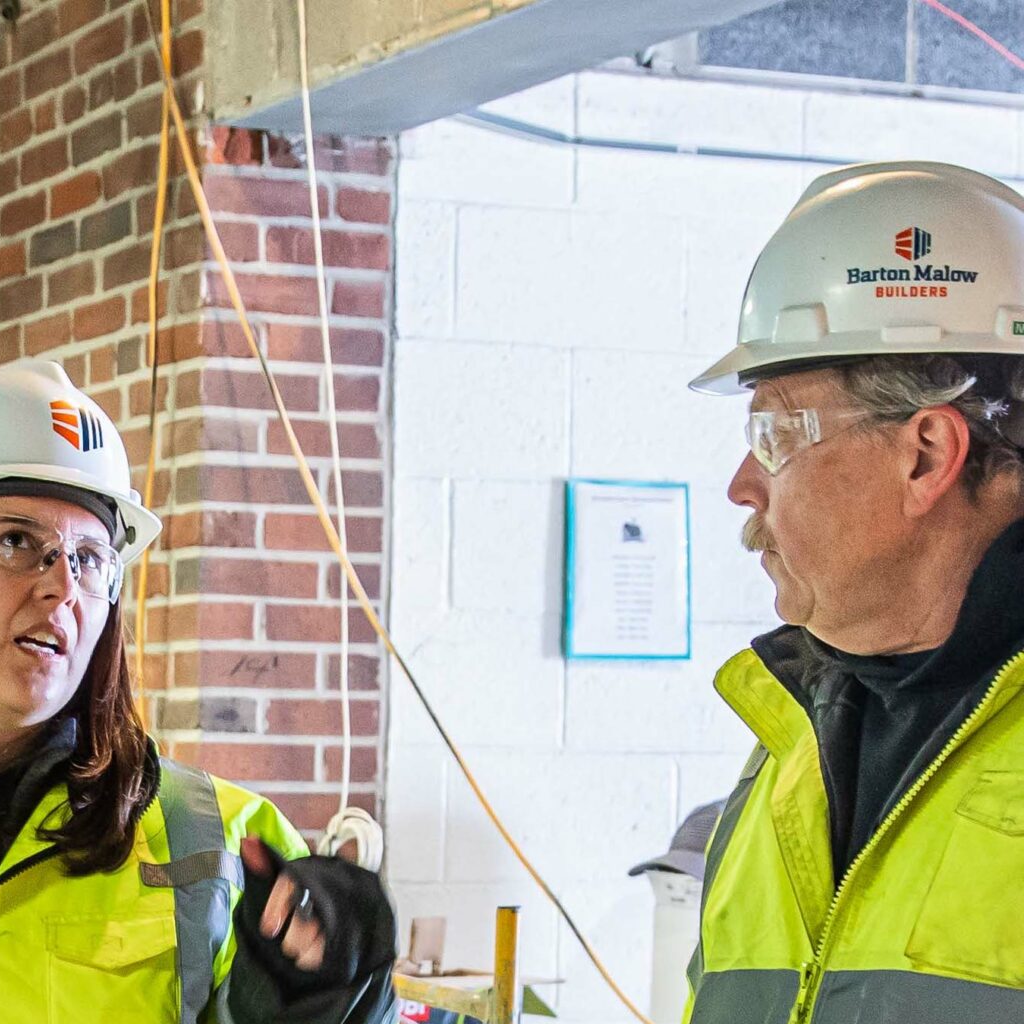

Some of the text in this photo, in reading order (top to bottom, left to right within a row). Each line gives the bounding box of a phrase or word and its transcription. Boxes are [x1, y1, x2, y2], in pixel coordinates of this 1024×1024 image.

[847, 265, 979, 284] Barton Malow
[876, 286, 948, 298] BUILDERS
